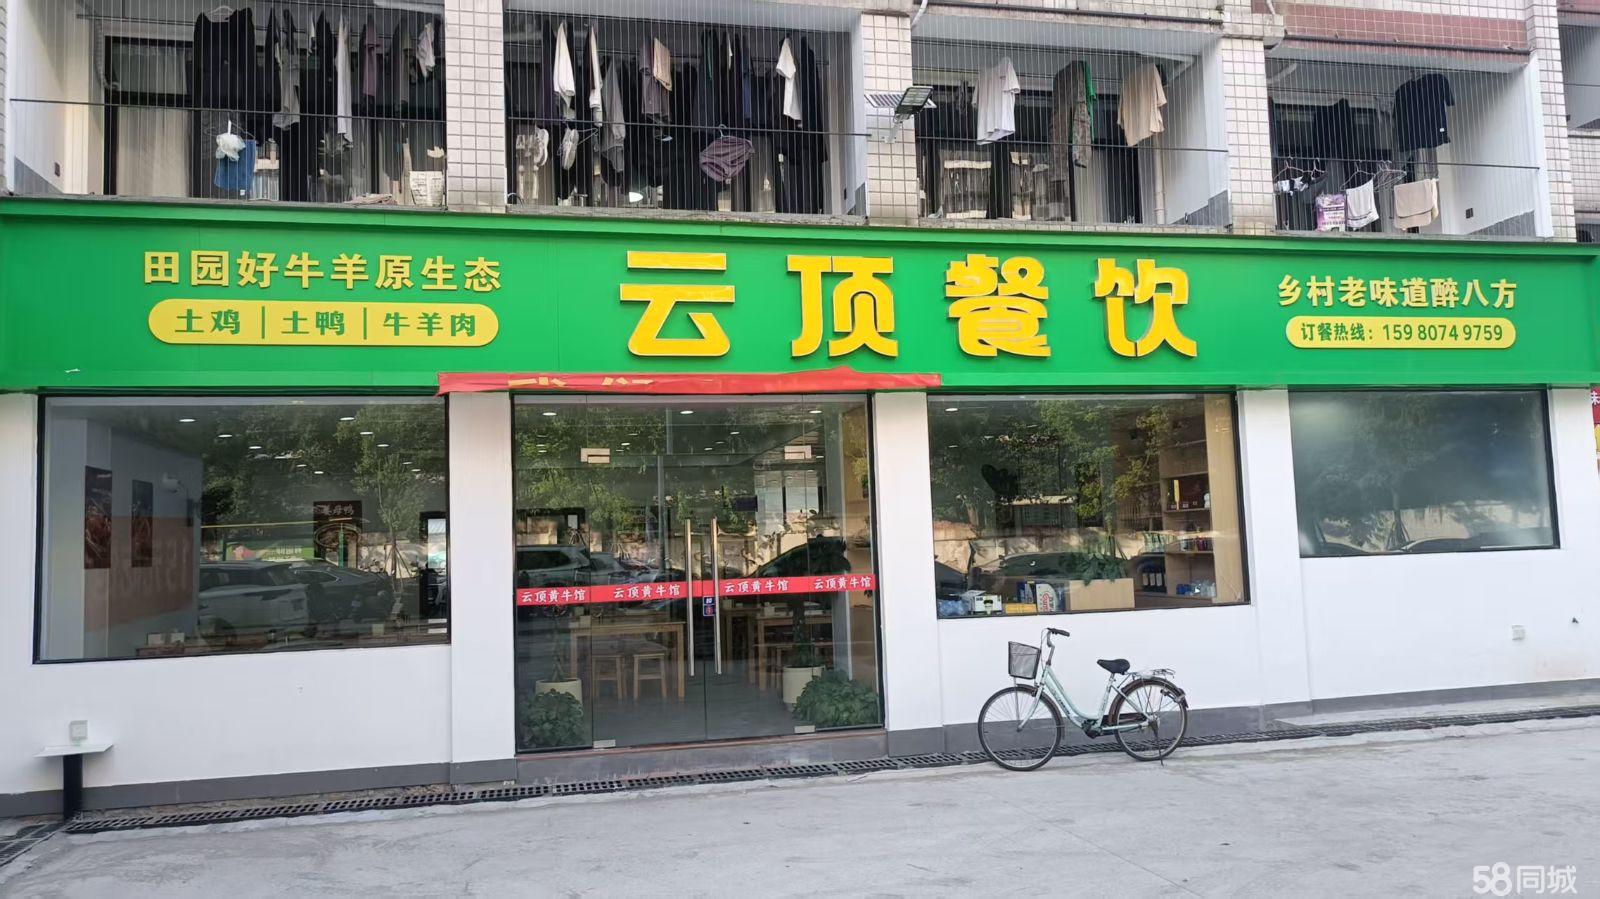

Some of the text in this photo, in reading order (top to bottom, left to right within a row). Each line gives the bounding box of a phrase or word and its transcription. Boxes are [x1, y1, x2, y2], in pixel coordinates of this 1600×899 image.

[144, 250, 502, 291] 田园好牛羊原生态
[1278, 274, 1517, 308] 乡村老味道醉八方
[619, 250, 1198, 358] 云顶餐饮
[175, 309, 477, 338] 土鸡 土鸭 牛羊肉
[613, 584, 680, 599] 云顶黄牛馆
[724, 579, 789, 593] 云顶黄牛馆
[813, 576, 872, 589] 云顶黄牛馆
[521, 588, 586, 603] 云顶黄牛馆
